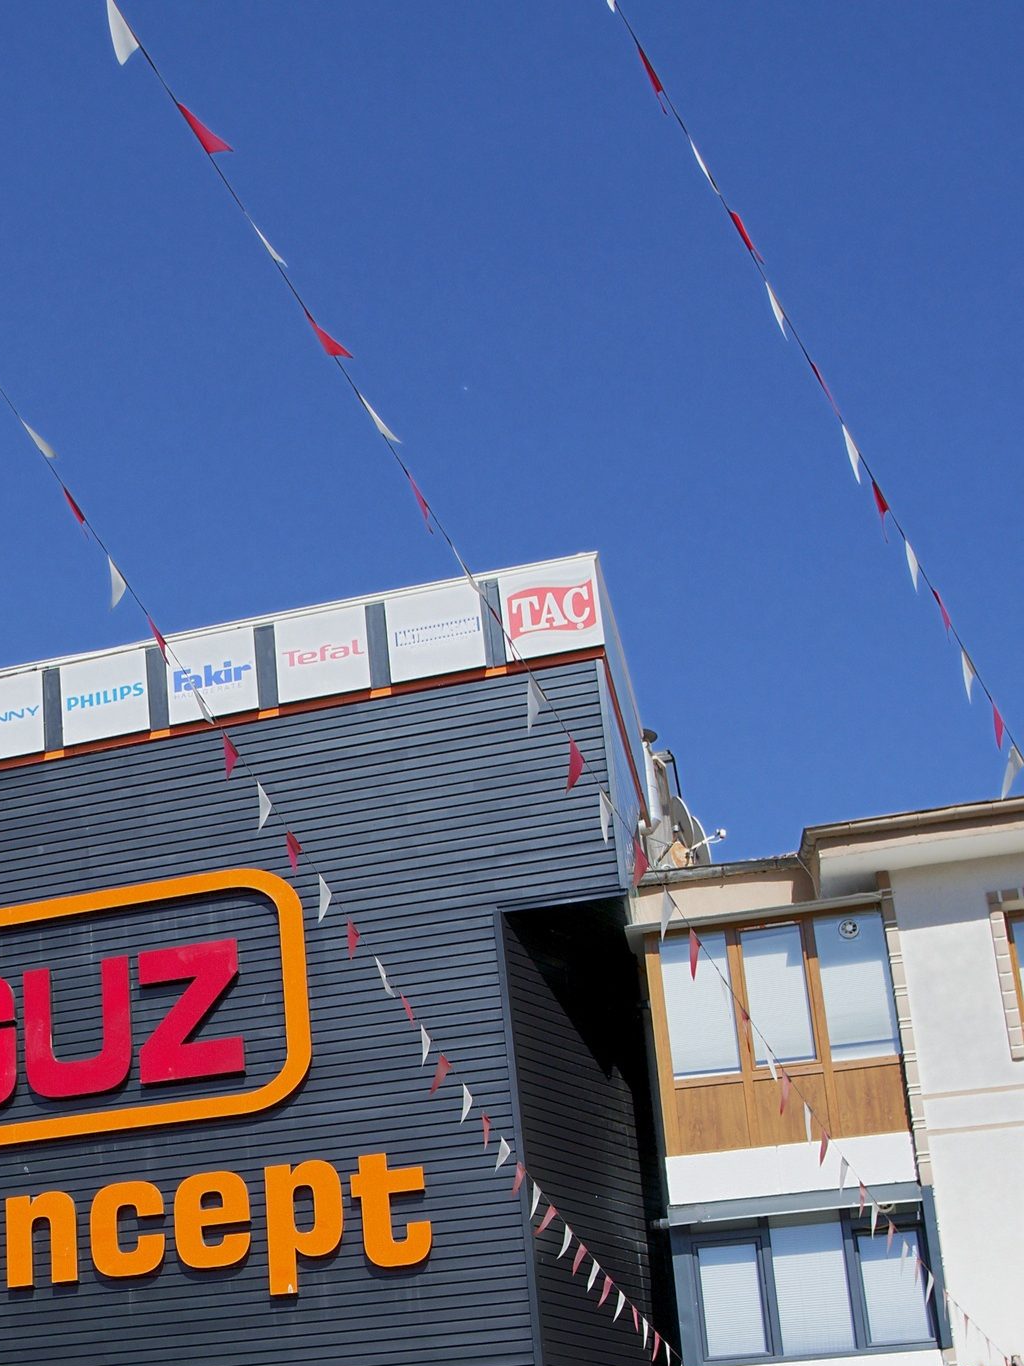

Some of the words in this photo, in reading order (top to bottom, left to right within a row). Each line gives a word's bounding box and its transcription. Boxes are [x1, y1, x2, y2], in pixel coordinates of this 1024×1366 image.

[512, 585, 590, 633] TAÇ
[282, 639, 365, 667] Tefal
[173, 660, 252, 693] Fakir
[67, 682, 144, 711] PHILIPS
